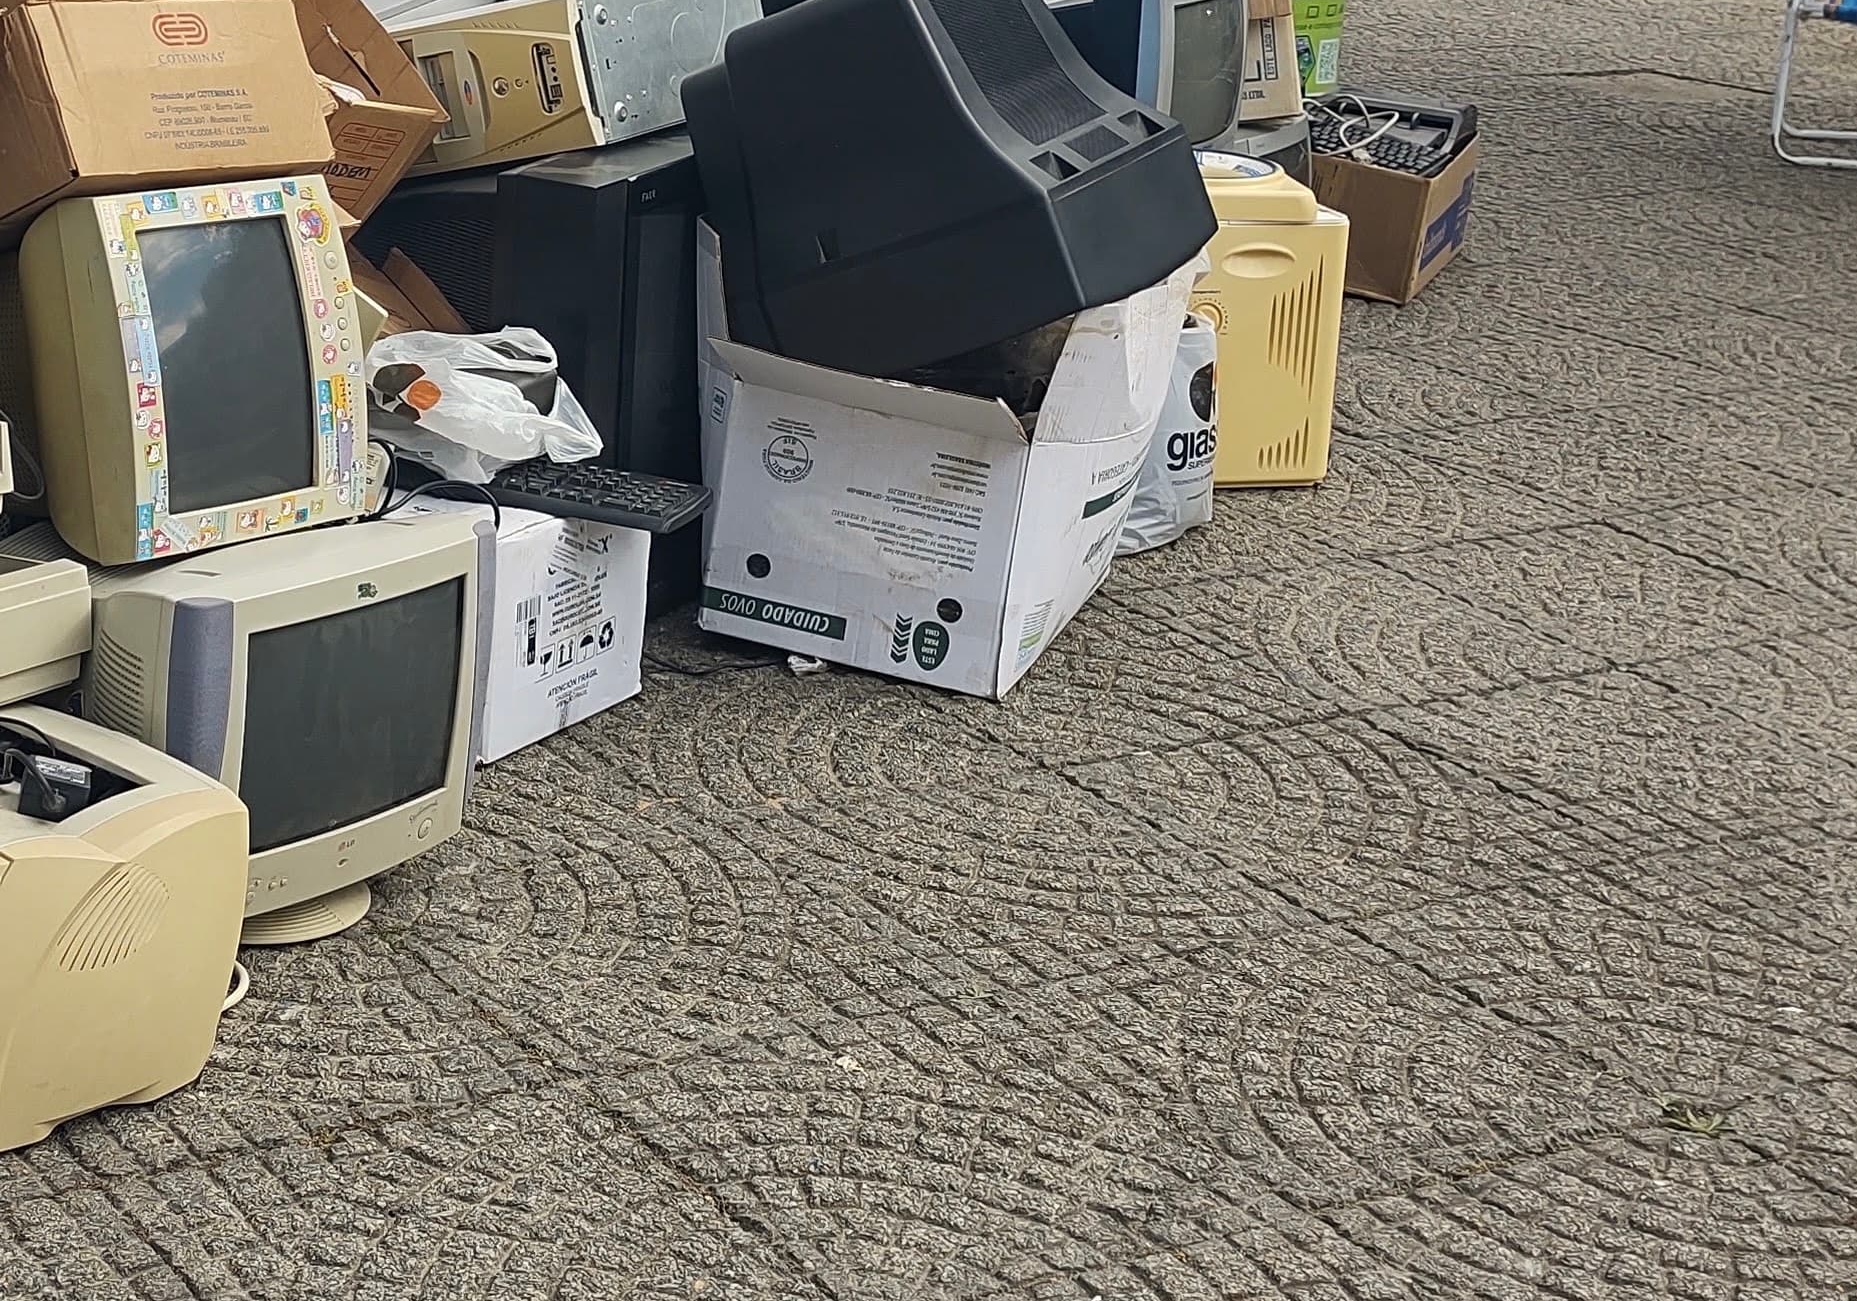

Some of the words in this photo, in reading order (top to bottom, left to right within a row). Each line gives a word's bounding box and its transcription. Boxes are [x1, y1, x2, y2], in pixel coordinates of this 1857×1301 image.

[158, 50, 225, 66] COTEMINAS
[773, 459, 802, 474] BRASIL
[719, 593, 756, 616] OVOS
[761, 602, 830, 633] CUIDADO
